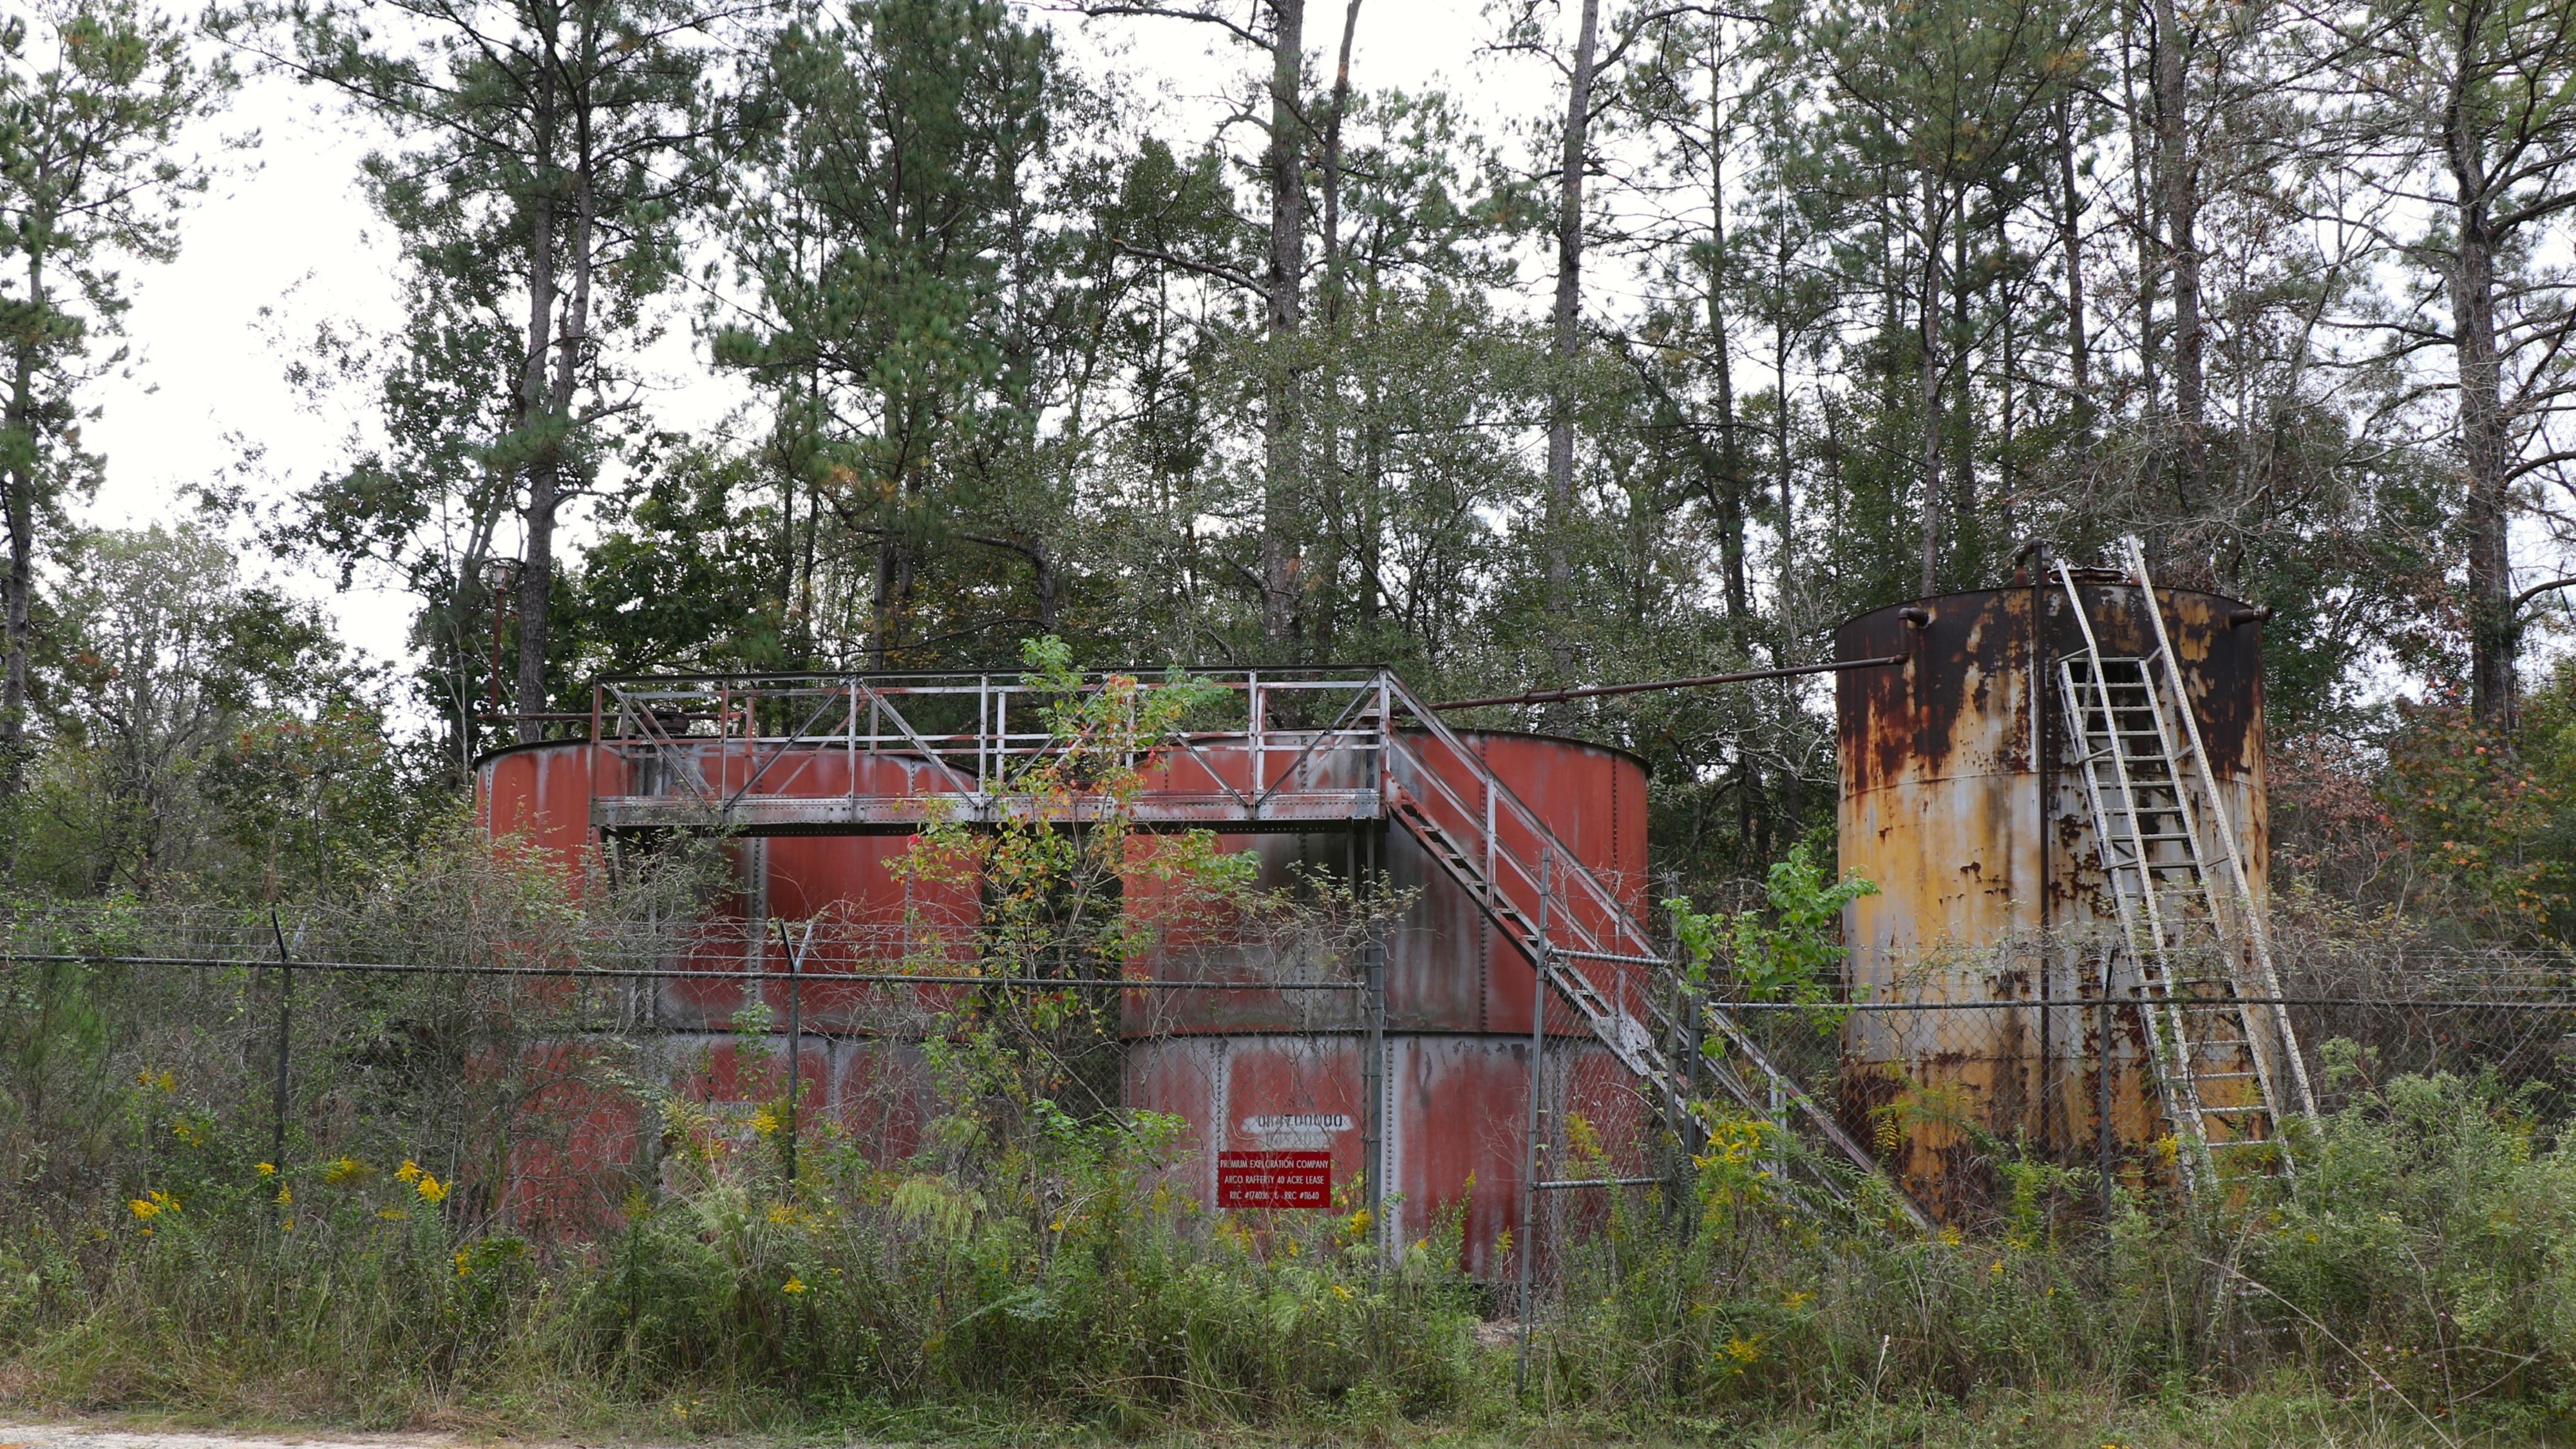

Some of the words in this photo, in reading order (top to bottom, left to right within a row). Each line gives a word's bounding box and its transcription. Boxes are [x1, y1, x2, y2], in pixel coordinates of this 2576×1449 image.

[1250, 1160, 1294, 1168] EXPLORATION
[1296, 1160, 1329, 1168] COMPANY
[1224, 1175, 1243, 1184] ARCO
[1245, 1175, 1274, 1184] RAFFERTY
[1277, 1175, 1285, 1184] 40
[1287, 1175, 1303, 1184] ACRE
[1305, 1176, 1324, 1184] LEASE
[1229, 1191, 1242, 1199] RRC
[1284, 1191, 1296, 1200] RRC
[1300, 1191, 1319, 1200] #11640
